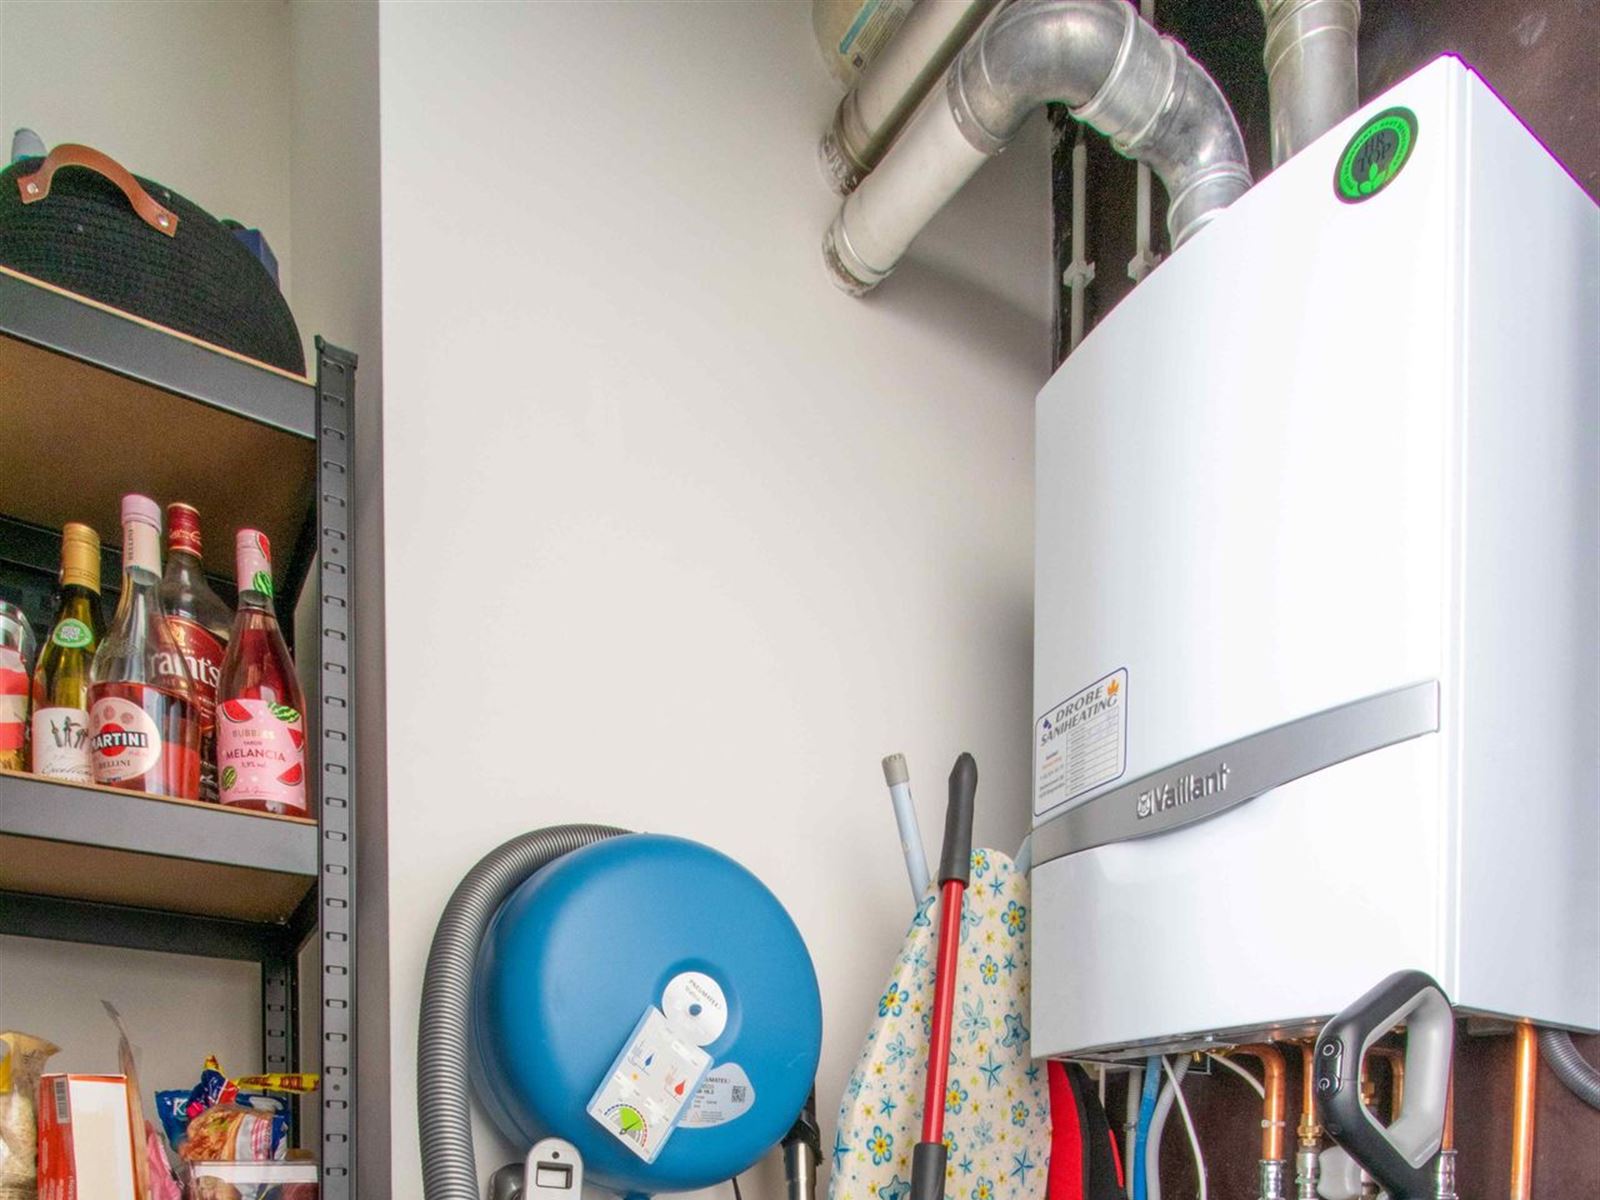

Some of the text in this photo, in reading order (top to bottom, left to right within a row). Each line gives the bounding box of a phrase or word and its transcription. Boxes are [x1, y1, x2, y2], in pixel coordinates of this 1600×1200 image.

[1040, 693, 1118, 747] SANIHEATING
[1055, 684, 1105, 723] DROBE
[91, 731, 146, 752] MARTINI
[225, 748, 287, 762] MELANCIA
[1154, 762, 1231, 812] Vaillant
